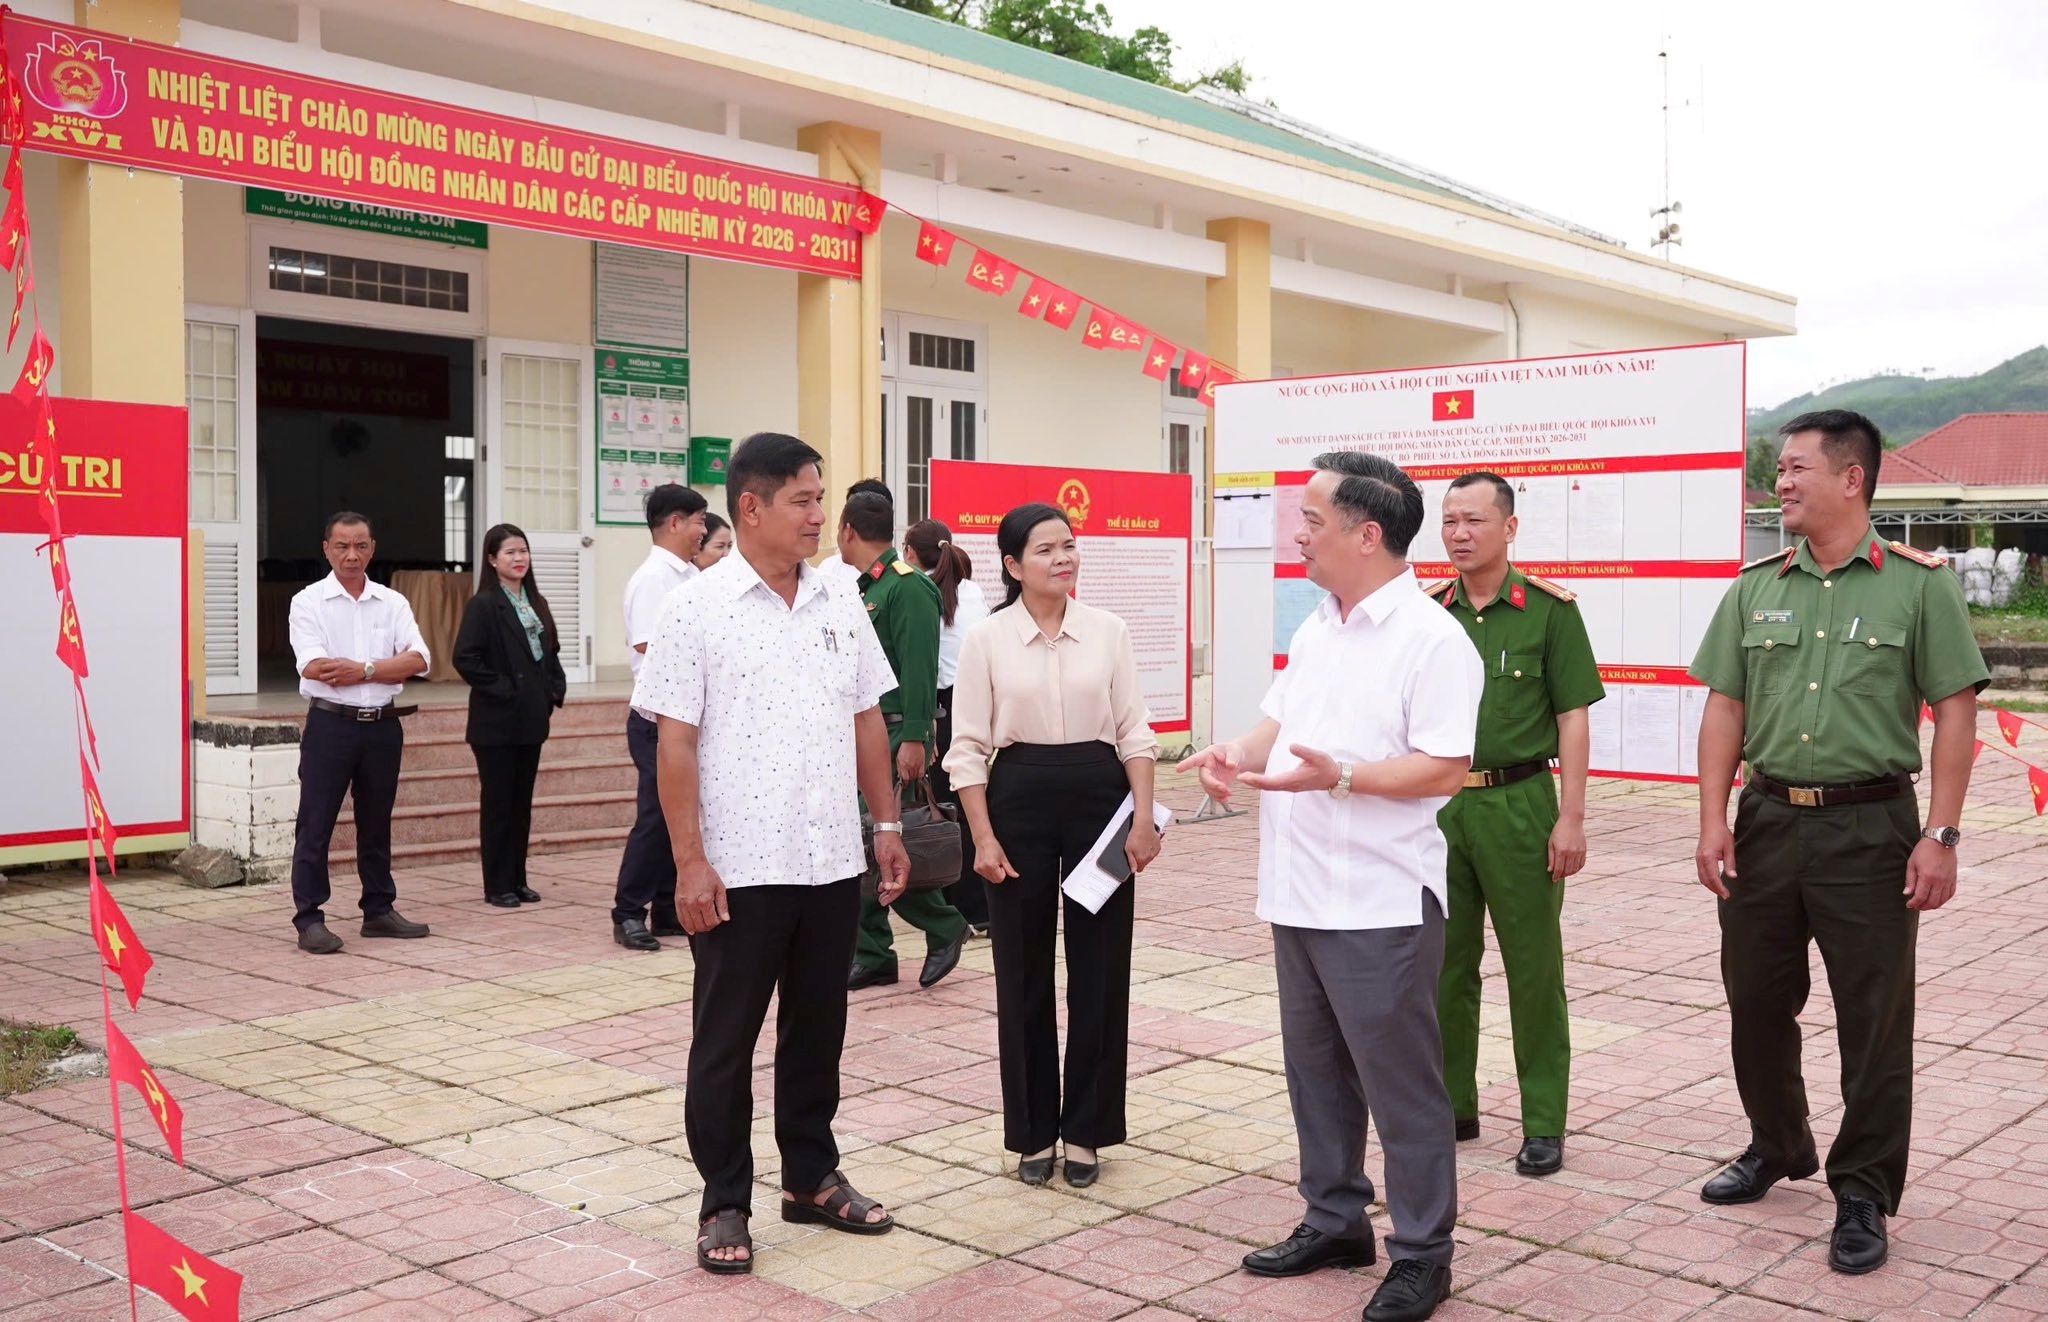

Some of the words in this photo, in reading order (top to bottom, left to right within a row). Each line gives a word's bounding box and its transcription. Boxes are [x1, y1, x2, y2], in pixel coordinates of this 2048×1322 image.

[32, 121, 122, 151] XVI
[148, 67, 231, 115] NHIỆT
[238, 84, 293, 127] LIỆT
[301, 98, 369, 137] CHÀO
[376, 111, 448, 152] MỪNG
[455, 128, 515, 165] NGÀY
[521, 136, 564, 174] BẦU
[570, 146, 602, 180] CỬ
[603, 159, 638, 191] ĐẠI
[643, 160, 688, 196] BIỂU
[693, 171, 742, 206] QUỐC
[747, 182, 777, 216] HỘI
[781, 189, 828, 221] KHÓA
[831, 199, 856, 226] XV
[152, 114, 189, 153] VÀ
[197, 125, 244, 166] ĐẠI
[253, 130, 312, 173] BIỂU
[321, 145, 363, 185] HỘI
[369, 151, 436, 194] ĐỒNG
[443, 169, 507, 206] NHÂN
[512, 179, 558, 214] DÂN
[563, 187, 605, 222] CÁC
[611, 193, 651, 229] CẤP
[657, 206, 718, 242] NHIỆM
[724, 215, 748, 245] KỲ
[752, 224, 794, 253] 2026
[810, 234, 857, 263] 2031!
[1279, 383, 1311, 398] NƯỚC
[1314, 382, 1347, 398] CỘNG
[1351, 378, 1377, 392] HÒA
[1380, 376, 1396, 391] XÃ
[1400, 376, 1422, 391] HỘI
[1426, 372, 1452, 387] CHỦ
[1456, 368, 1498, 385] NGHĨA
[1501, 367, 1532, 384] VIỆT
[1536, 366, 1566, 380] NAM
[1571, 360, 1613, 377] MUÔN
[1617, 358, 1655, 374] NĂM!
[1388, 431, 1400, 440] TRI
[1416, 429, 1439, 438] DANH
[1440, 426, 1463, 436] SÁCH
[1499, 421, 1520, 433] VIÊN
[1522, 422, 1538, 433] ĐẠI
[1562, 419, 1587, 431] QUỐC
[1591, 418, 1607, 430] HỘI
[1611, 415, 1637, 427] KHÓA
[1640, 416, 1655, 425] XVI
[1379, 443, 1393, 452] HỘI
[1420, 438, 1442, 448] NHÂN
[1445, 437, 1461, 447] DÂN
[1504, 434, 1533, 446] NHIỆM
[1550, 432, 1587, 442] 2026-2031
[1500, 446, 1531, 457] KHÁNH
[61, 455, 121, 489] TRI
[1494, 465, 1507, 475] ĐẠI
[1528, 462, 1549, 473] QUỐC
[1551, 463, 1565, 473] HỘI
[1567, 461, 1589, 471] KHÓA
[1590, 461, 1605, 470] XVI
[959, 511, 974, 525] NỘI
[975, 514, 991, 524] QUY
[1107, 515, 1121, 528] THỂ
[1122, 517, 1130, 530] LỆ
[1529, 565, 1549, 575] NHÂN
[1551, 565, 1567, 575] DÂN
[1587, 563, 1615, 574] KHÁNH
[1617, 563, 1634, 574] HÒA
[1608, 669, 1638, 679] KHÁNH
[1639, 671, 1657, 680] SƠN
